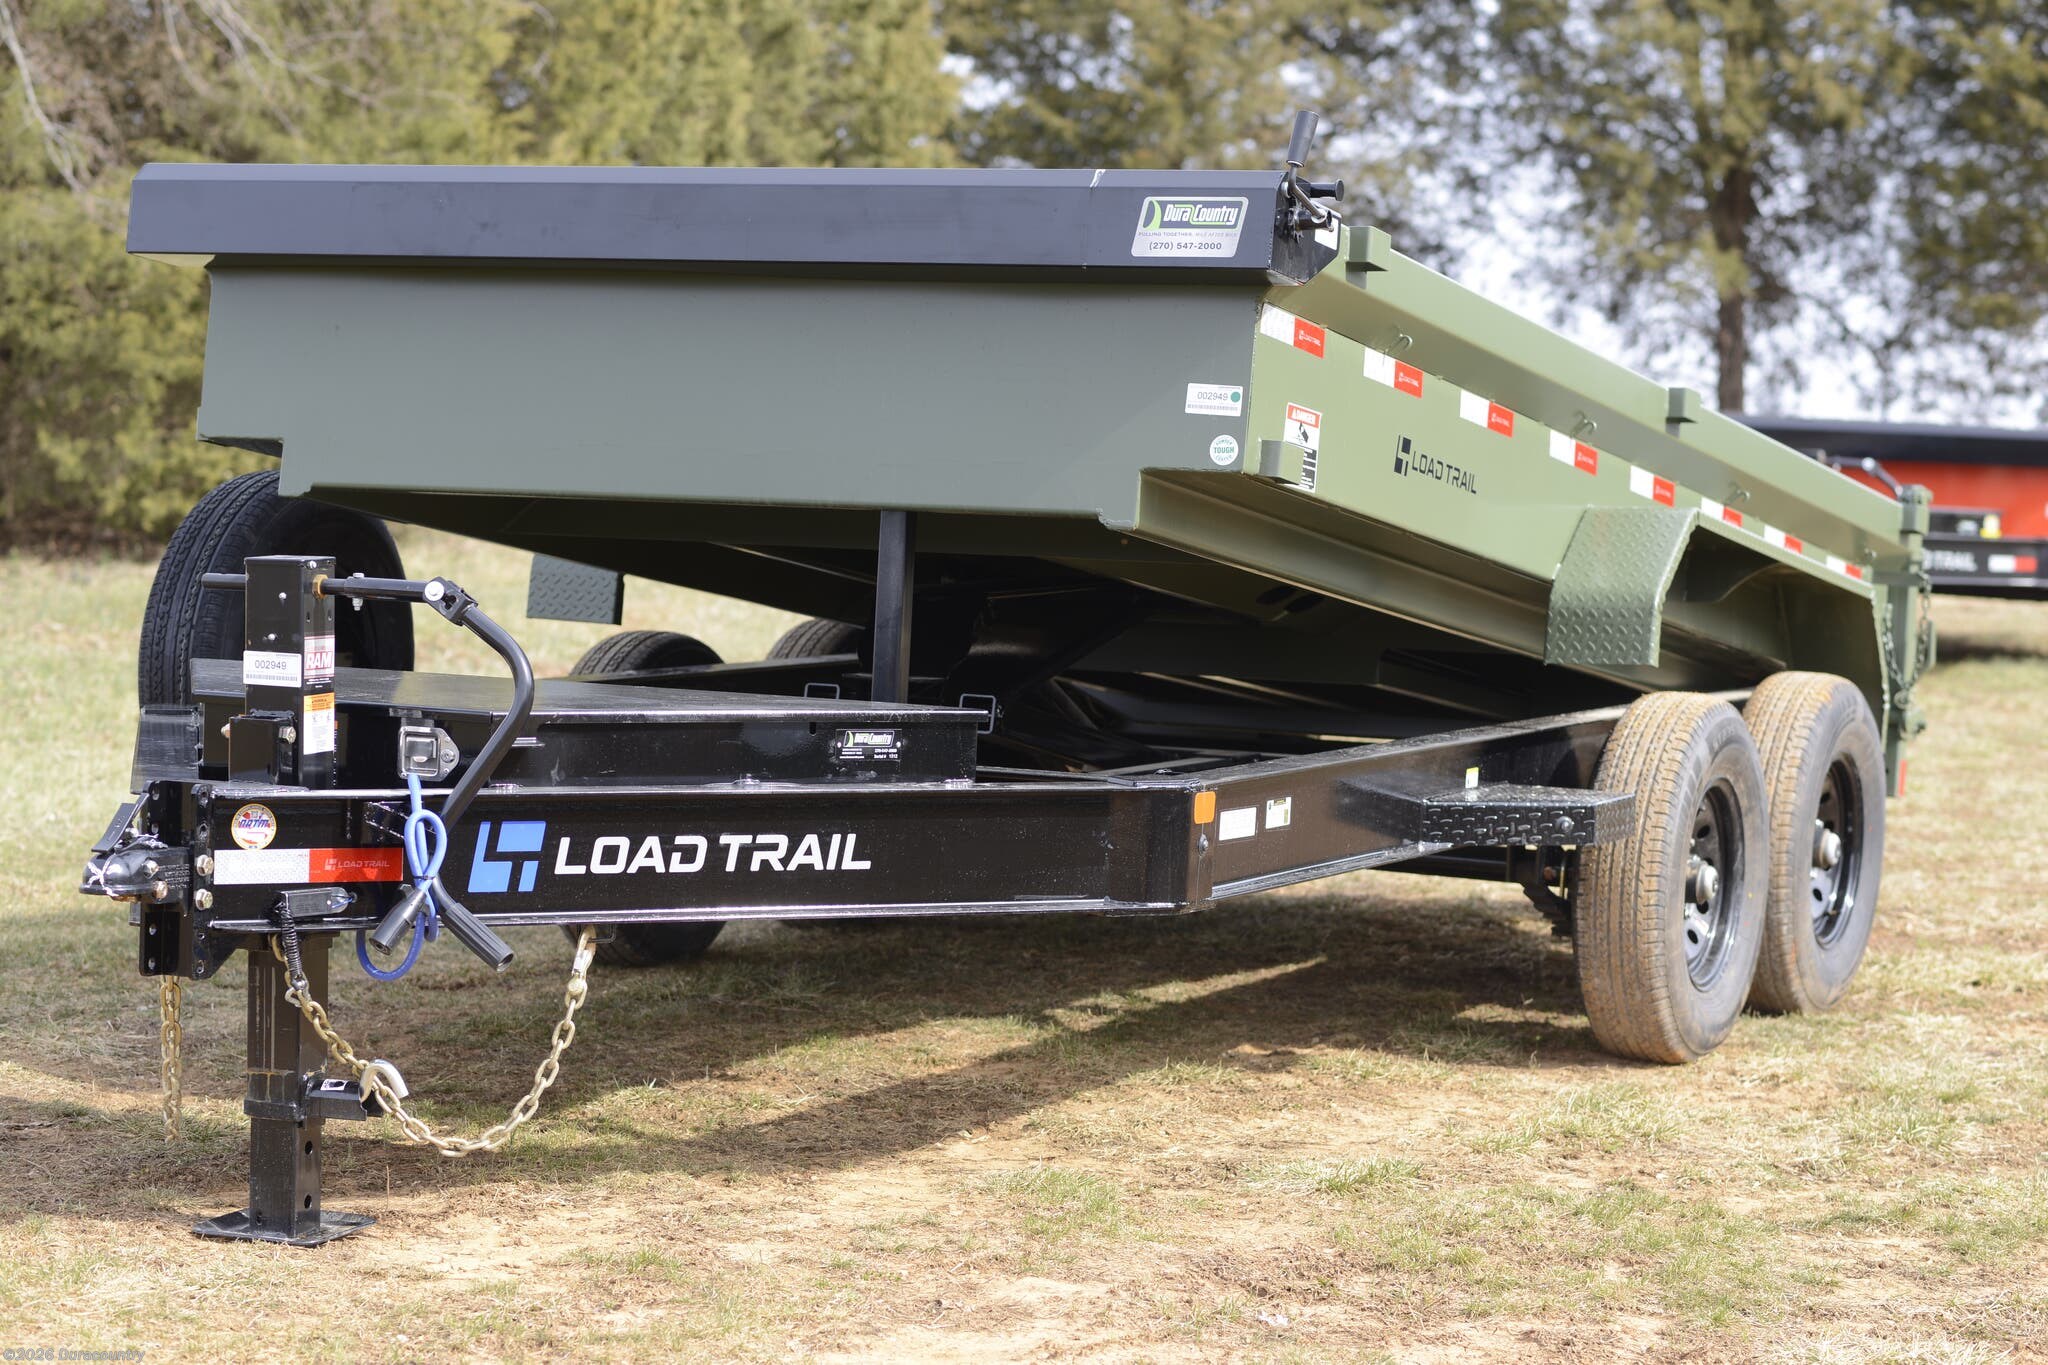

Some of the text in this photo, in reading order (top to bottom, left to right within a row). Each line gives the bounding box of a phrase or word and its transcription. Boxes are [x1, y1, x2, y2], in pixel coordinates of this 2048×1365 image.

[1163, 203, 1239, 226] Dura Country
[1149, 242, 1222, 251] (270) 547-2000
[1197, 391, 1229, 401] 002949
[1213, 446, 1235, 454] TOUGH
[1412, 450, 1477, 494] LOAD TRAIL
[254, 659, 287, 670] 002949
[306, 651, 333, 669] RAM
[554, 833, 872, 875] LOAD TRAIL
[337, 860, 390, 868] LOAD TRAIL
